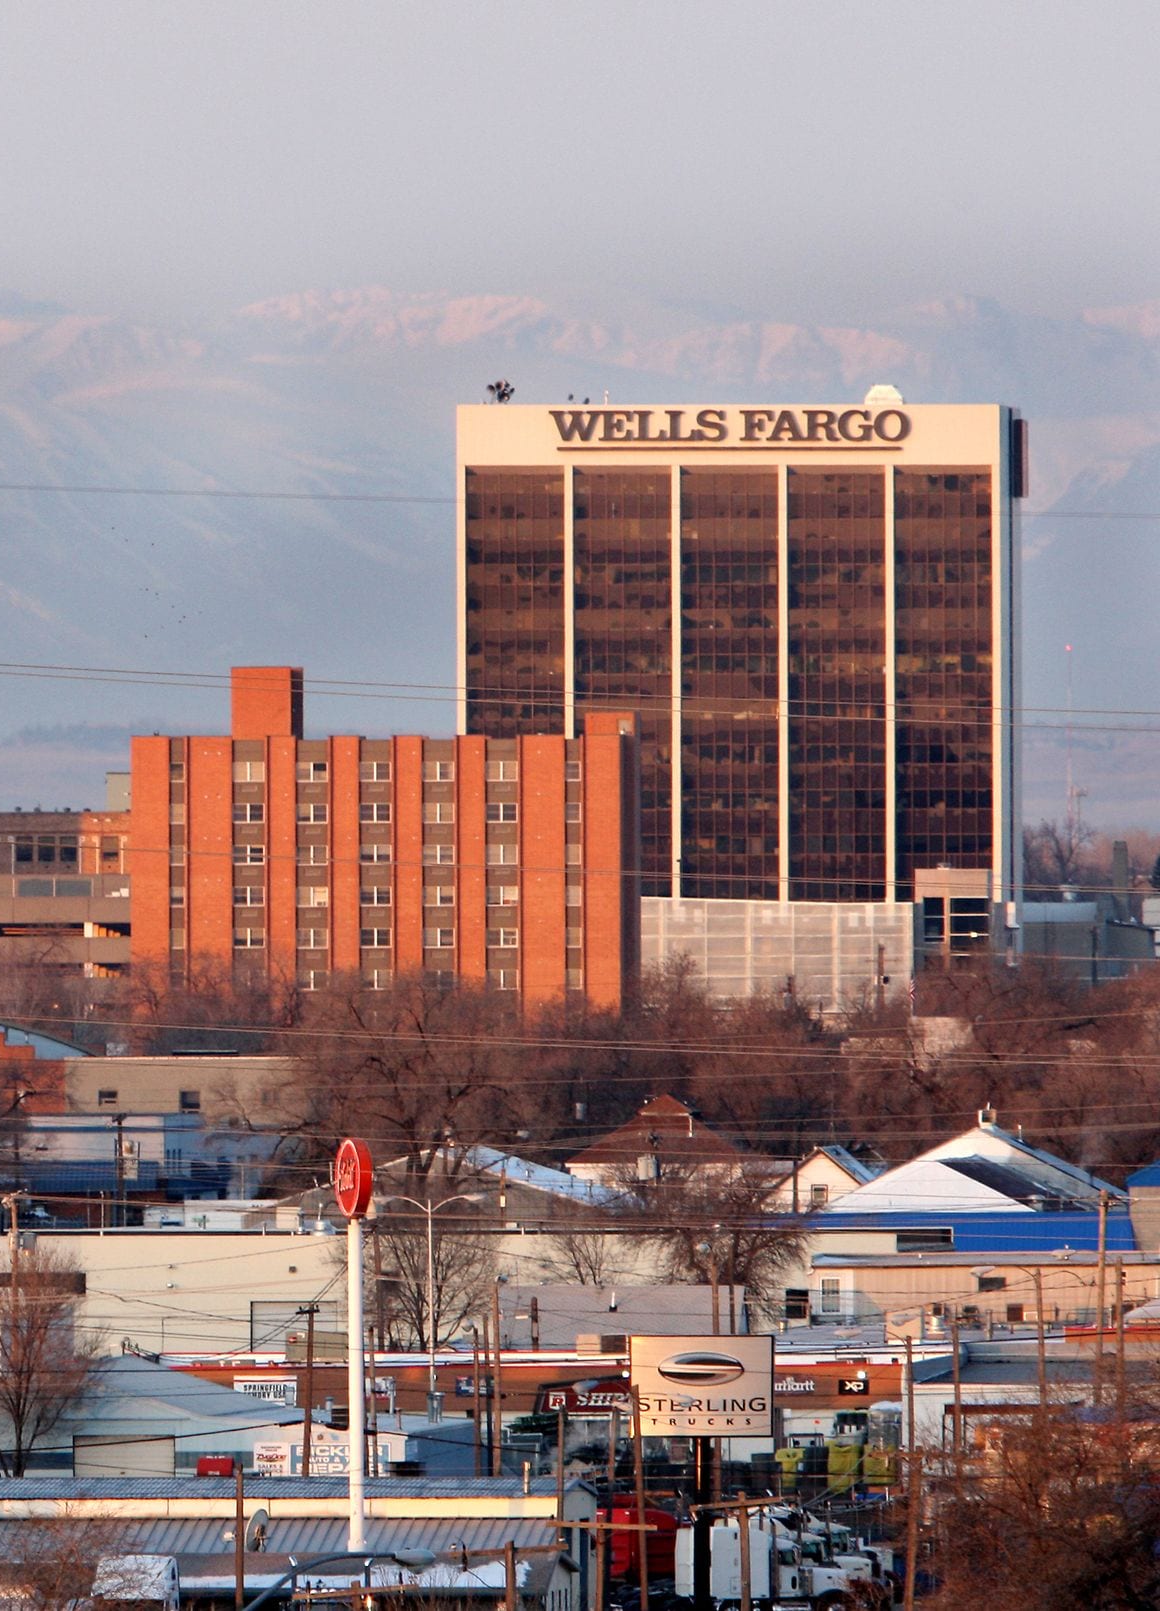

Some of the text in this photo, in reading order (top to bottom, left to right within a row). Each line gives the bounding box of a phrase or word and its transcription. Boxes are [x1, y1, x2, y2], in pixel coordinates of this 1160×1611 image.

[548, 409, 912, 442] WELLS FARGO
[639, 1397, 767, 1412] STERLING
